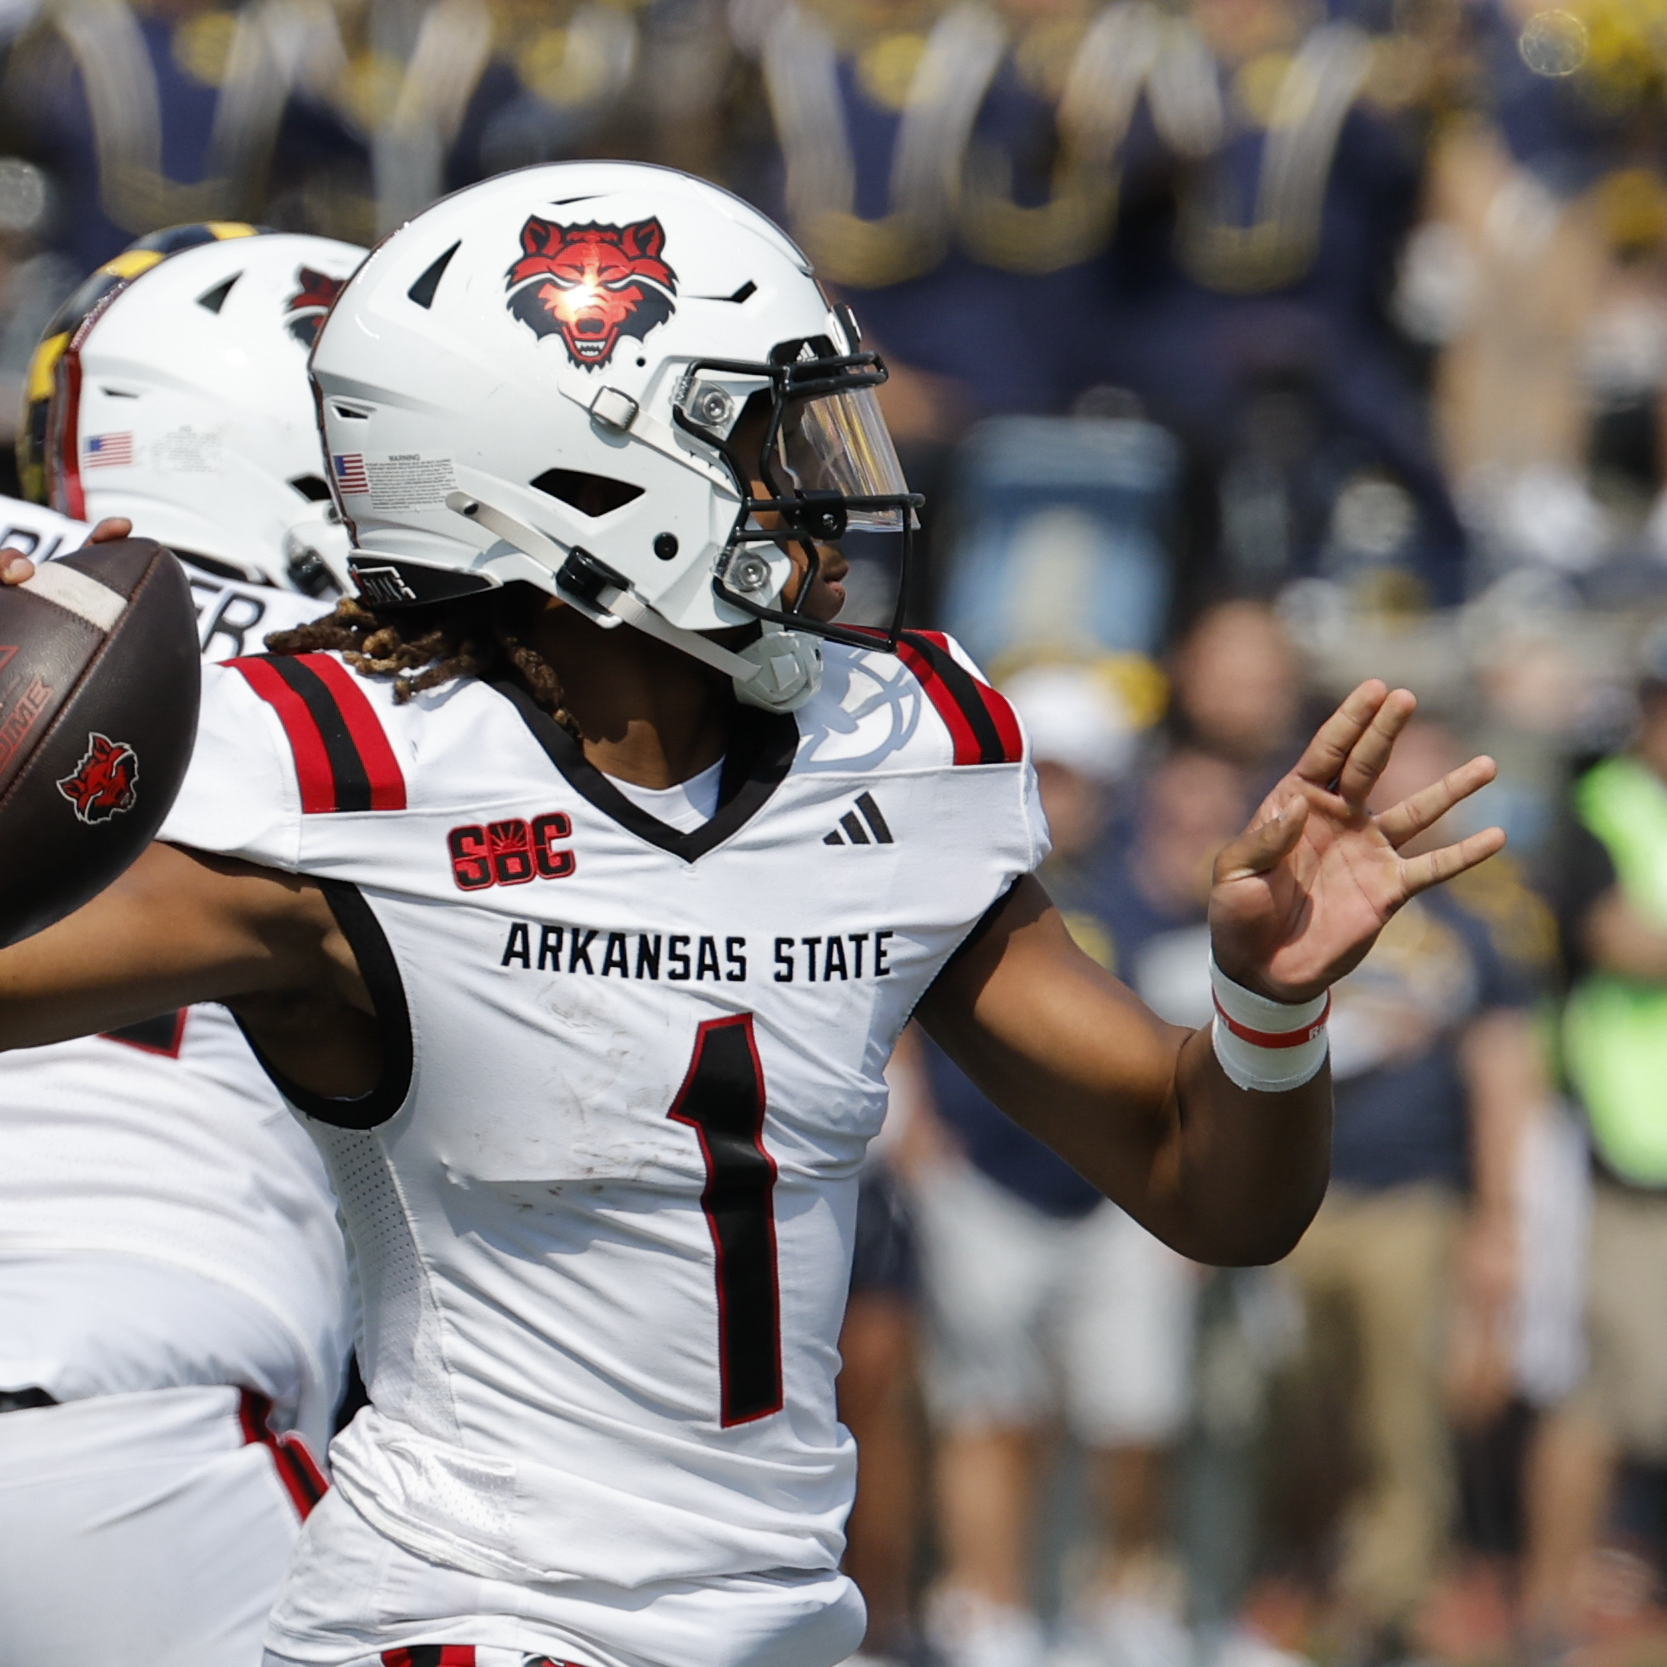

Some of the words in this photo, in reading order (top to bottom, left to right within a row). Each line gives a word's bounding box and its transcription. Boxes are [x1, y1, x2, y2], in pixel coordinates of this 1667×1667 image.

[446, 811, 576, 892] SBC
[501, 922, 747, 982] ARKANSAS
[774, 930, 894, 983] STATE
[666, 1012, 783, 1429] 1
